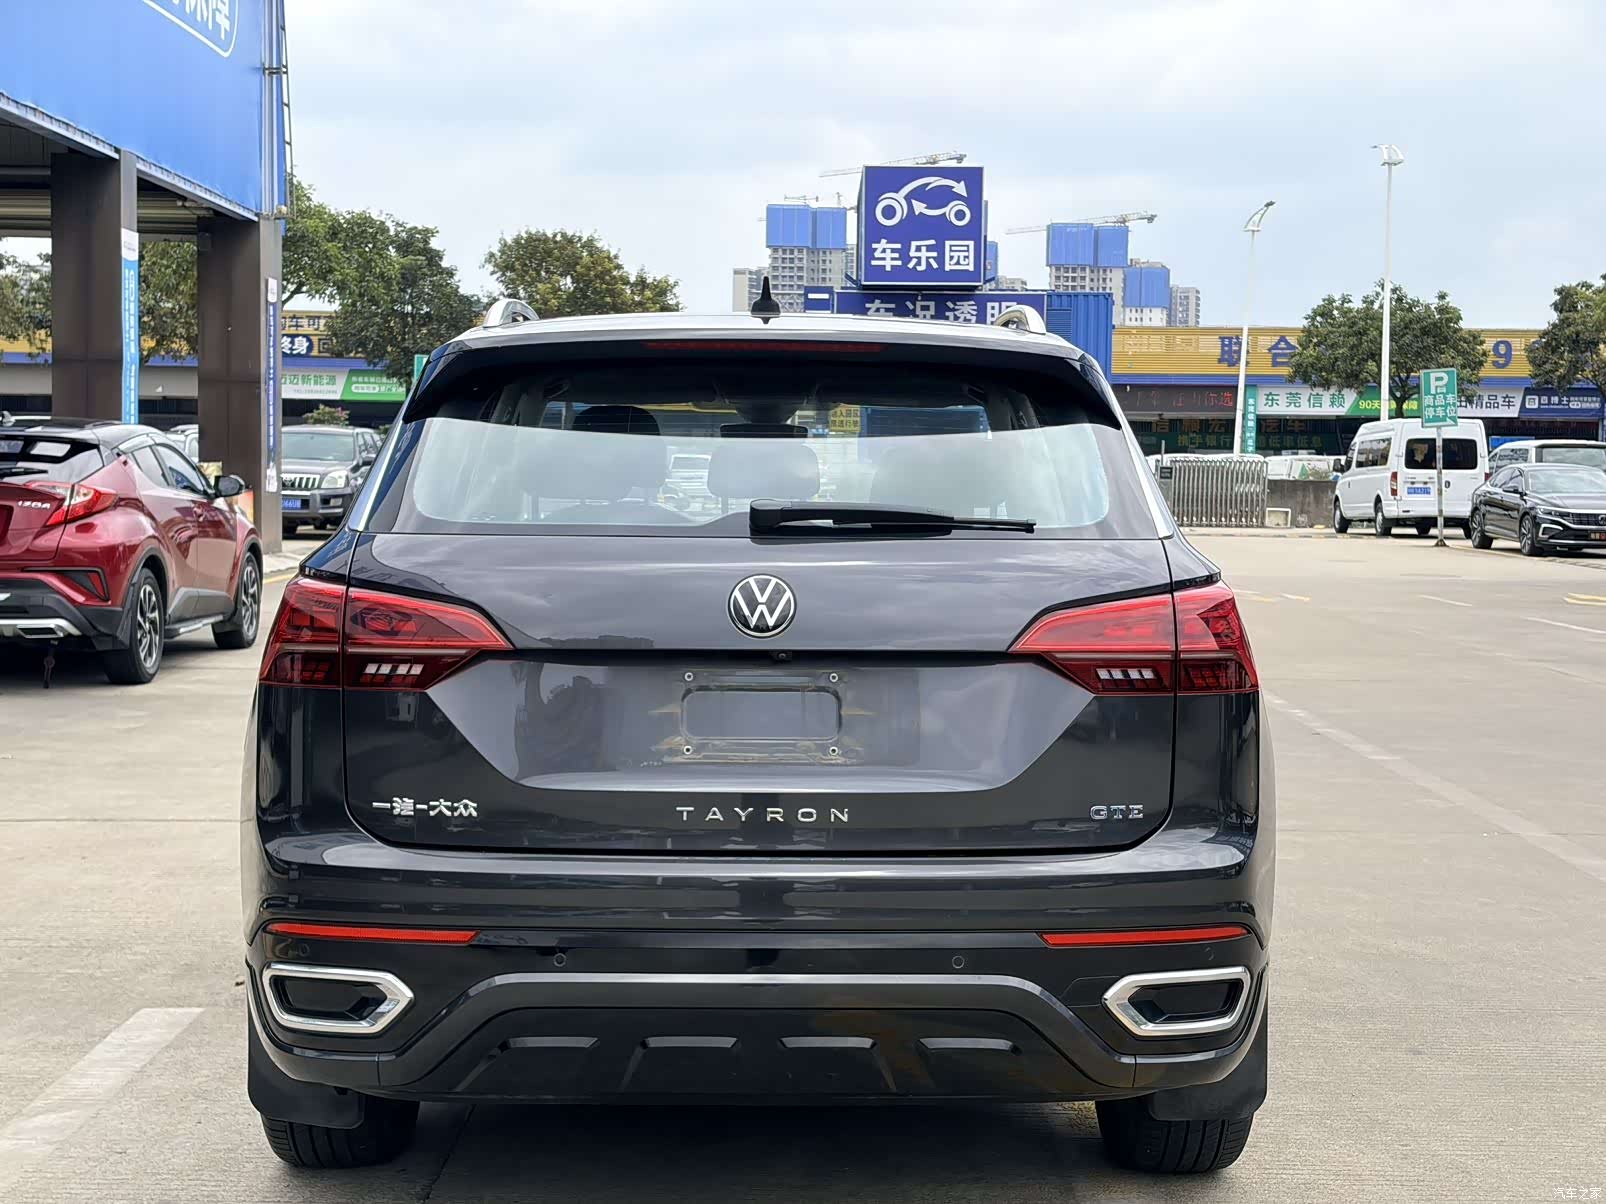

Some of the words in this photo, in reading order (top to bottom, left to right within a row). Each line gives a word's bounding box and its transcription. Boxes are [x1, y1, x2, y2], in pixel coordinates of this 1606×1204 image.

[871, 239, 975, 271] 车乐园
[1430, 372, 1448, 394] P
[1263, 391, 1346, 409] 东莞信赖
[1424, 394, 1457, 406] 商品车
[1425, 406, 1457, 418] 停车位
[372, 797, 478, 817] 一汽-大众
[676, 806, 849, 823] TAYRON
[1089, 804, 1144, 820] GTE
